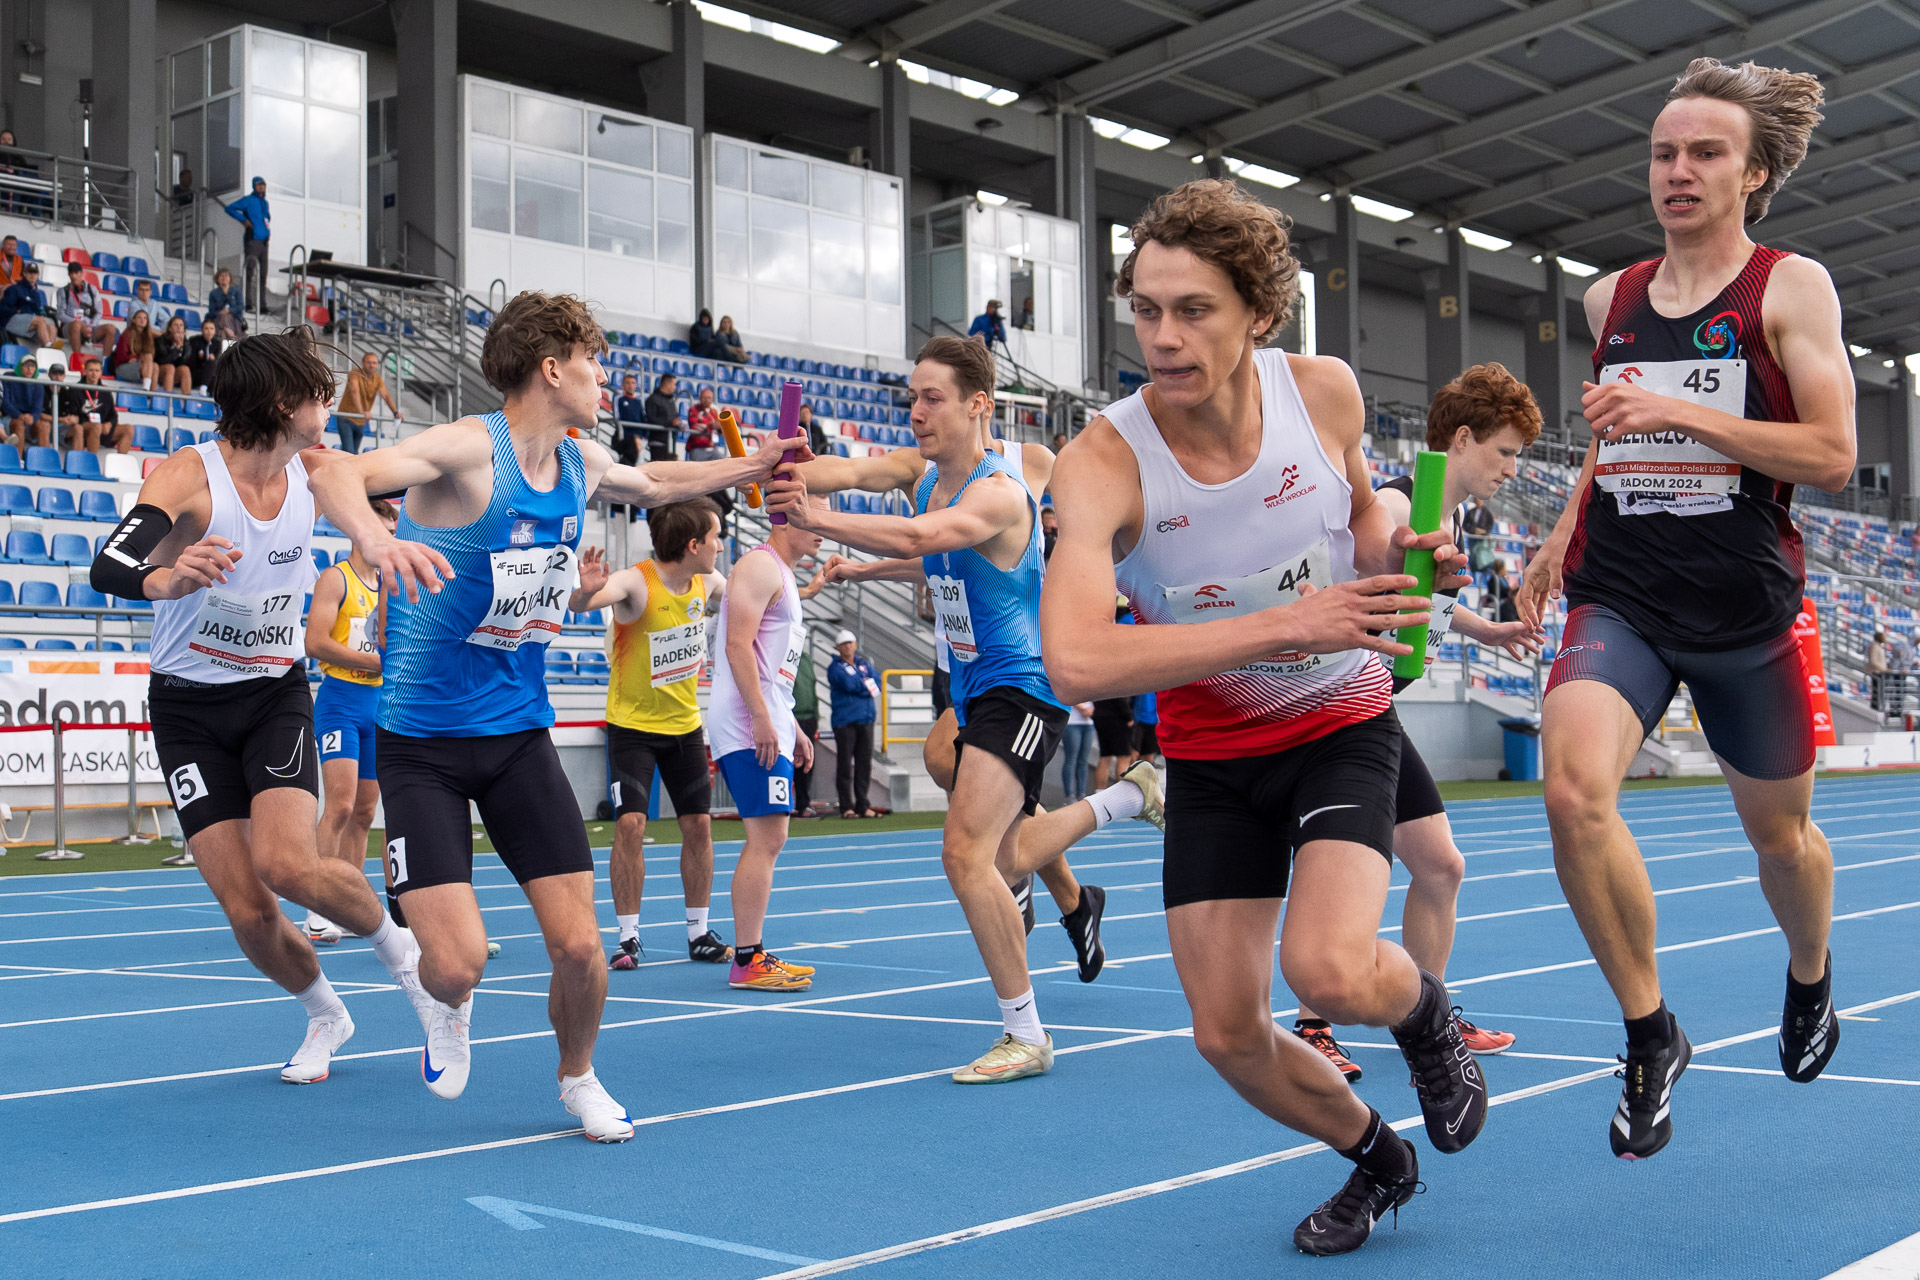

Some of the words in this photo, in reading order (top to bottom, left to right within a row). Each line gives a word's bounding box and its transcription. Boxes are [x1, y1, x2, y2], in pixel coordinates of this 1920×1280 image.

[1327, 268, 1347, 291] C
[1439, 296, 1459, 318] B
[1538, 322, 1557, 342] B
[1683, 368, 1721, 393] 45
[1629, 463, 1680, 472] Mistrzostwa
[1682, 464, 1707, 473] Polski
[1709, 465, 1727, 473] U20
[1620, 478, 1665, 488] RADOM
[1668, 479, 1702, 489] 2024
[1265, 497, 1286, 509] WLKS
[507, 563, 536, 576] FUEL
[1278, 558, 1310, 592] 44
[940, 585, 960, 601] 209
[261, 595, 291, 615] 177
[1194, 600, 1236, 610] ORLEN
[199, 620, 294, 647] JABŁOŃSKI
[685, 622, 704, 638] 213
[210, 658, 245, 673] RADOM
[247, 666, 269, 674] 2024
[1286, 655, 1321, 673] 2024
[326, 733, 336, 750] 2
[175, 768, 196, 801] 5
[776, 779, 787, 802] 3
[388, 845, 399, 883] 6
